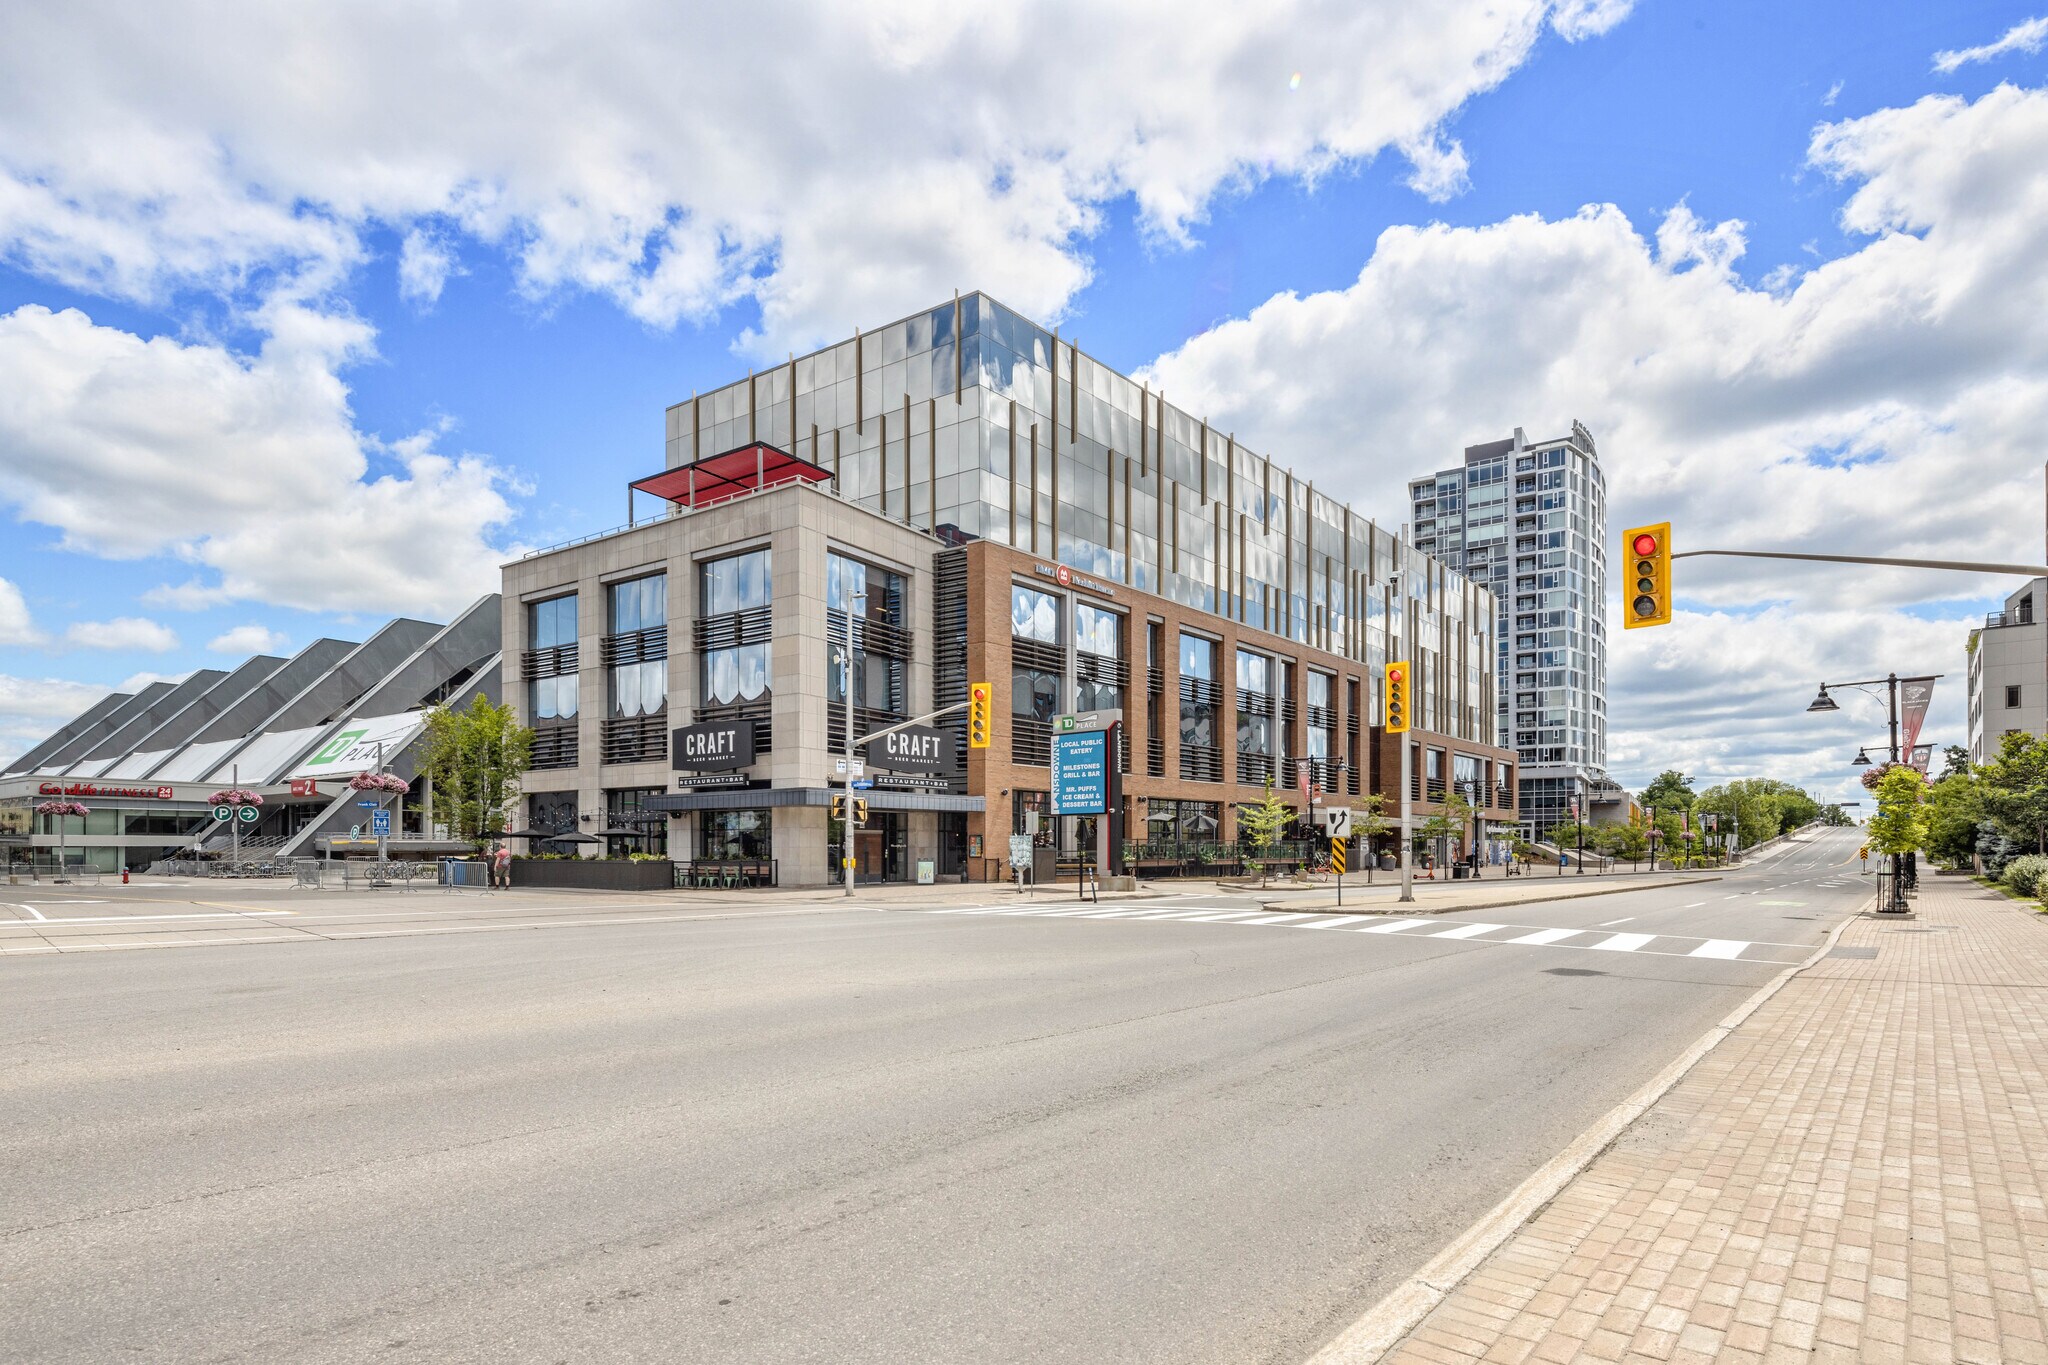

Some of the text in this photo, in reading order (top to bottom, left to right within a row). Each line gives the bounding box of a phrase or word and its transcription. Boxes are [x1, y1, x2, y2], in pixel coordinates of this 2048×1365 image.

[1063, 718, 1073, 728] TD
[686, 730, 736, 756] CRAFT
[887, 732, 941, 758] CRAFT
[1070, 747, 1093, 755] EATERY
[1063, 763, 1101, 771] MILESTONES
[680, 777, 725, 785] RESTAURANT
[878, 777, 929, 786] RESTAURANT
[39, 782, 154, 798] GoodLife FITNESS
[304, 780, 313, 795] 2
[218, 807, 229, 819] P
